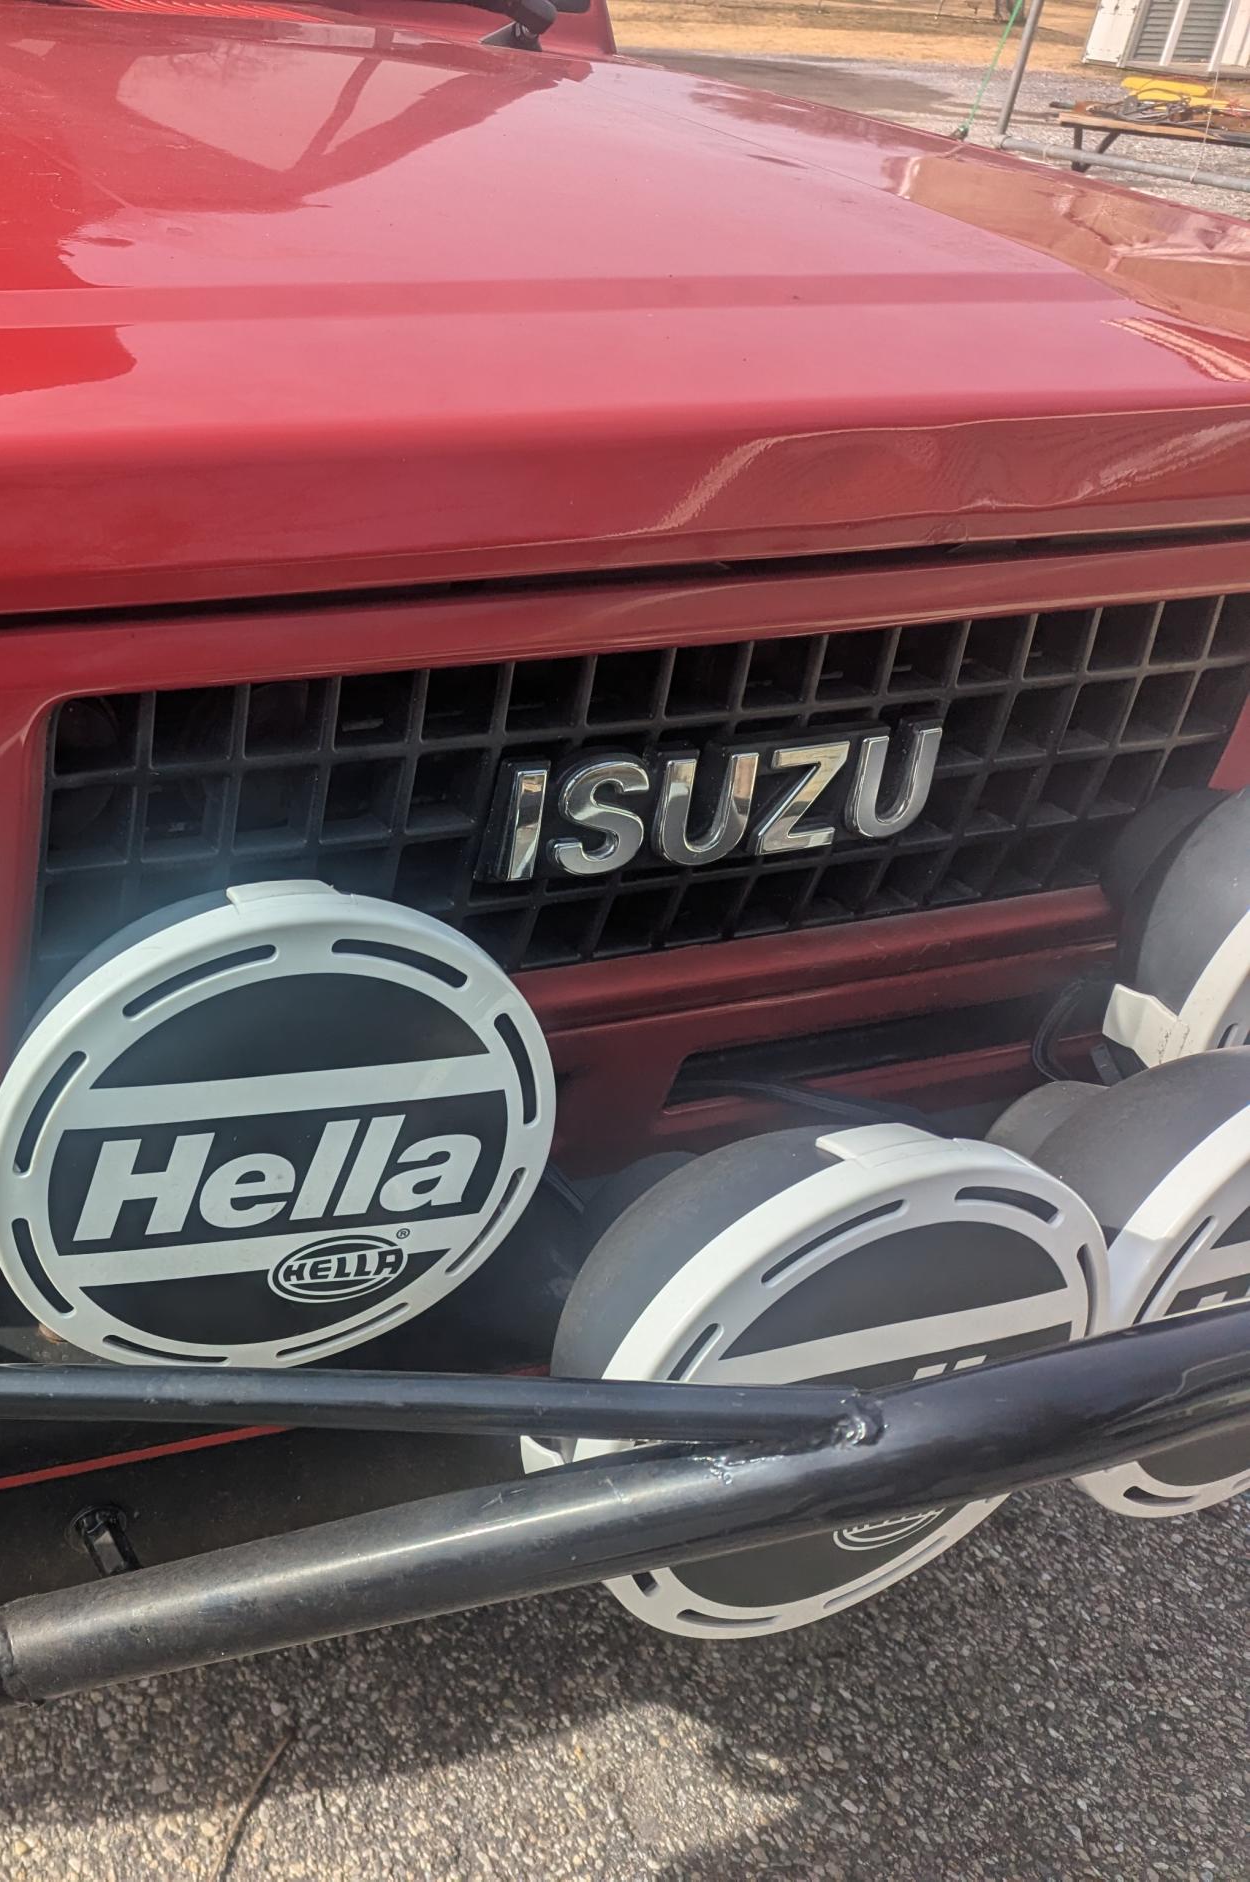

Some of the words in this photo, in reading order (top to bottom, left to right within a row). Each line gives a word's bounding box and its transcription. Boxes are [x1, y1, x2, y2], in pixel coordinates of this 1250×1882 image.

[502, 726, 944, 883] ISUZU
[72, 1113, 483, 1242] Hella
[282, 1247, 404, 1283] HELLA
